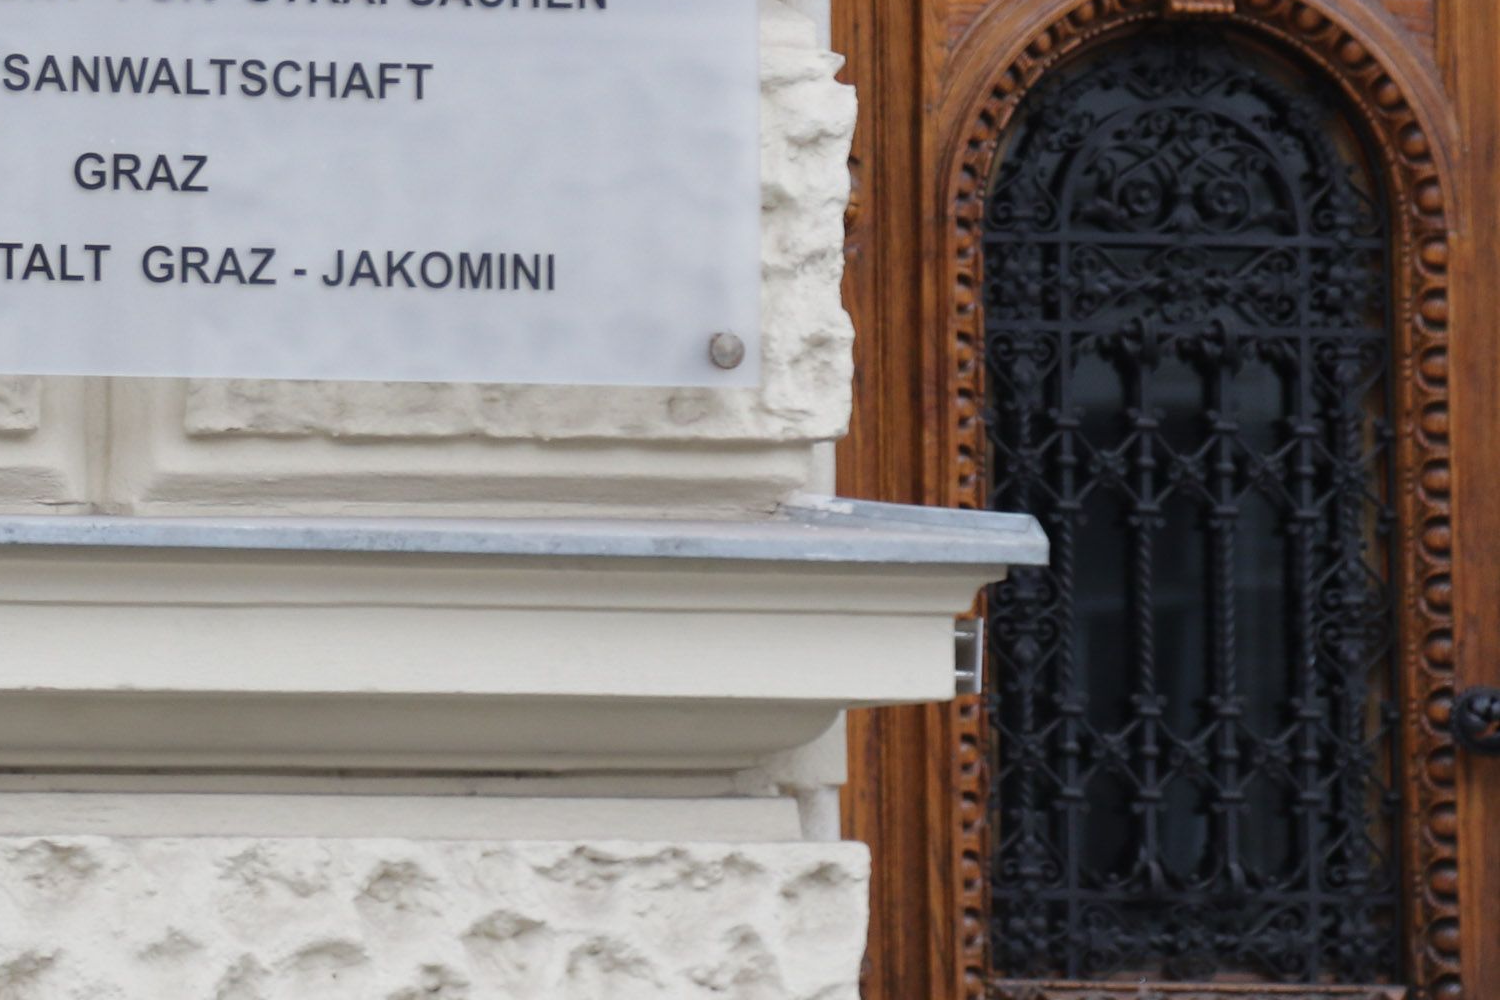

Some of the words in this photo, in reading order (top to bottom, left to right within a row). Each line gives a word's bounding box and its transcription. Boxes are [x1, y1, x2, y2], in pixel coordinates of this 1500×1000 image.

[73, 152, 210, 193] GRAZ
[141, 246, 276, 286] GRAZ
[293, 268, 307, 276] -
[322, 249, 555, 291] JAKOMINI
